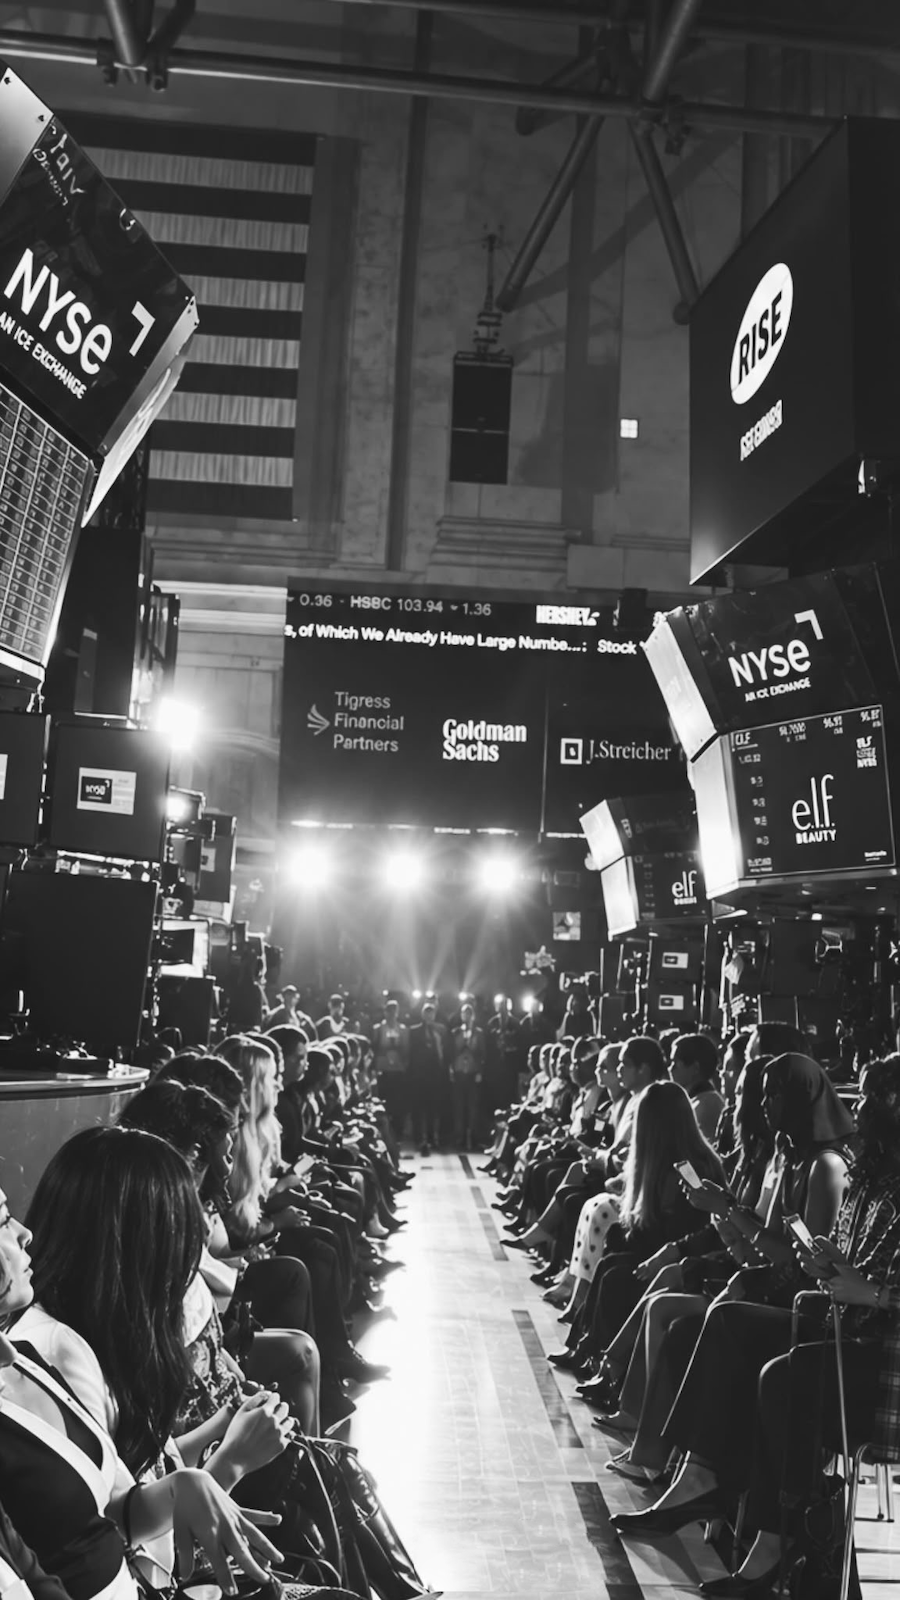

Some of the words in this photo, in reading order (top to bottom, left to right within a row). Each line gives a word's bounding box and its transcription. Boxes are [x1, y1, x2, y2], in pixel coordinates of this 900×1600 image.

[738, 289, 783, 385] RISE
[0, 311, 14, 336] AN
[13, 324, 33, 352] ICE
[32, 343, 88, 400] EXCHANGE
[299, 593, 333, 608] 0.36
[350, 595, 392, 611] HSBC
[397, 598, 444, 613] 103.94
[462, 602, 492, 616] 1.36
[298, 623, 315, 637] of
[316, 624, 359, 640] Which
[361, 627, 384, 641] We
[385, 628, 438, 647] Already
[440, 632, 475, 646] Have
[476, 633, 517, 651] Large
[597, 639, 637, 655] Stock
[334, 691, 391, 710] Tigress
[333, 713, 404, 731] Financial
[442, 718, 527, 744] Goldman
[333, 734, 399, 753] Partners
[442, 740, 500, 762] Sachs
[586, 739, 672, 765] J.Streicher
[795, 829, 837, 845] BEAUTY
